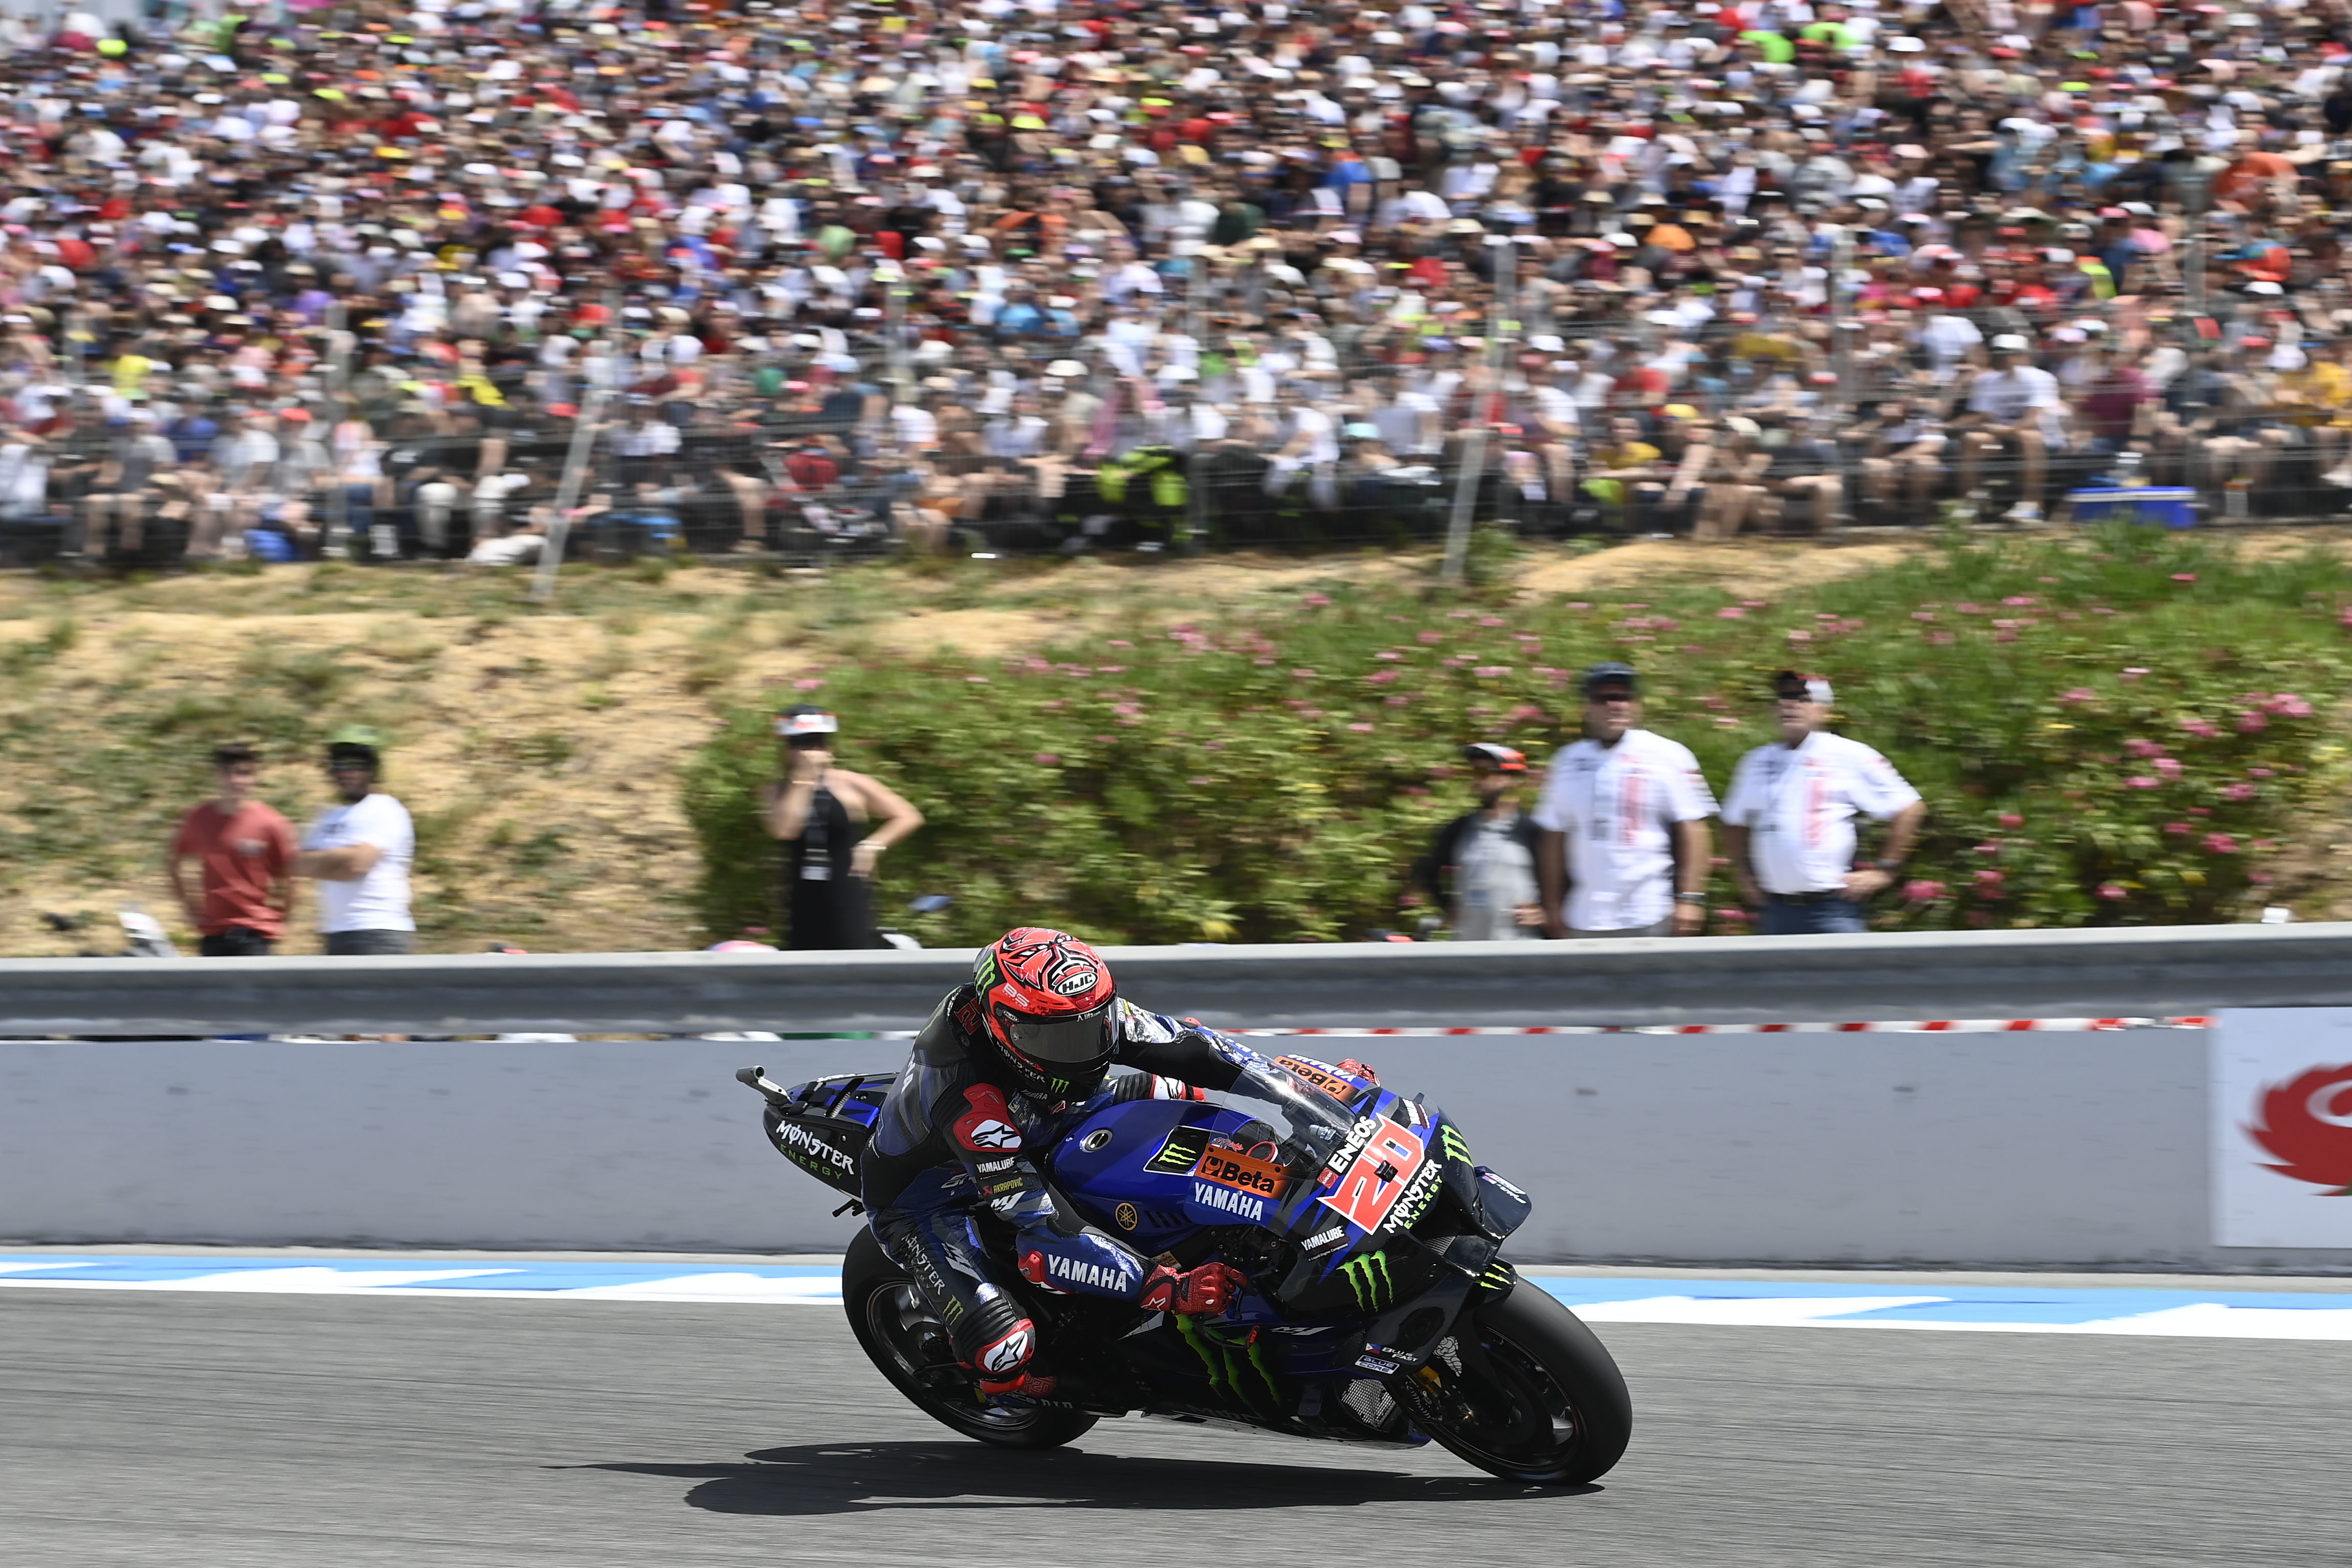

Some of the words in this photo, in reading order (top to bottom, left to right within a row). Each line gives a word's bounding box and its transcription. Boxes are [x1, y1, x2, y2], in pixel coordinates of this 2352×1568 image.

[1003, 982, 1030, 1007] BS
[1062, 974, 1093, 993] HJC
[775, 1119, 855, 1175] MONSTER
[1327, 1115, 1378, 1174] ENEOS
[780, 1144, 844, 1180] ENERGY
[977, 1157, 1015, 1173] YAMALUBE
[1221, 1161, 1275, 1194] Beta
[1316, 1112, 1425, 1235] 20
[1194, 1182, 1263, 1222] YAMAHA
[1382, 1159, 1443, 1234] MONSTER
[1403, 1176, 1443, 1230] ENERGY
[1301, 1225, 1345, 1251] YAMALUBE
[1048, 1254, 1127, 1292] YAMAHA
[1360, 1362, 1390, 1373] CORE
[1363, 1357, 1395, 1368] BLUE
[1391, 1354, 1418, 1362] FAST
